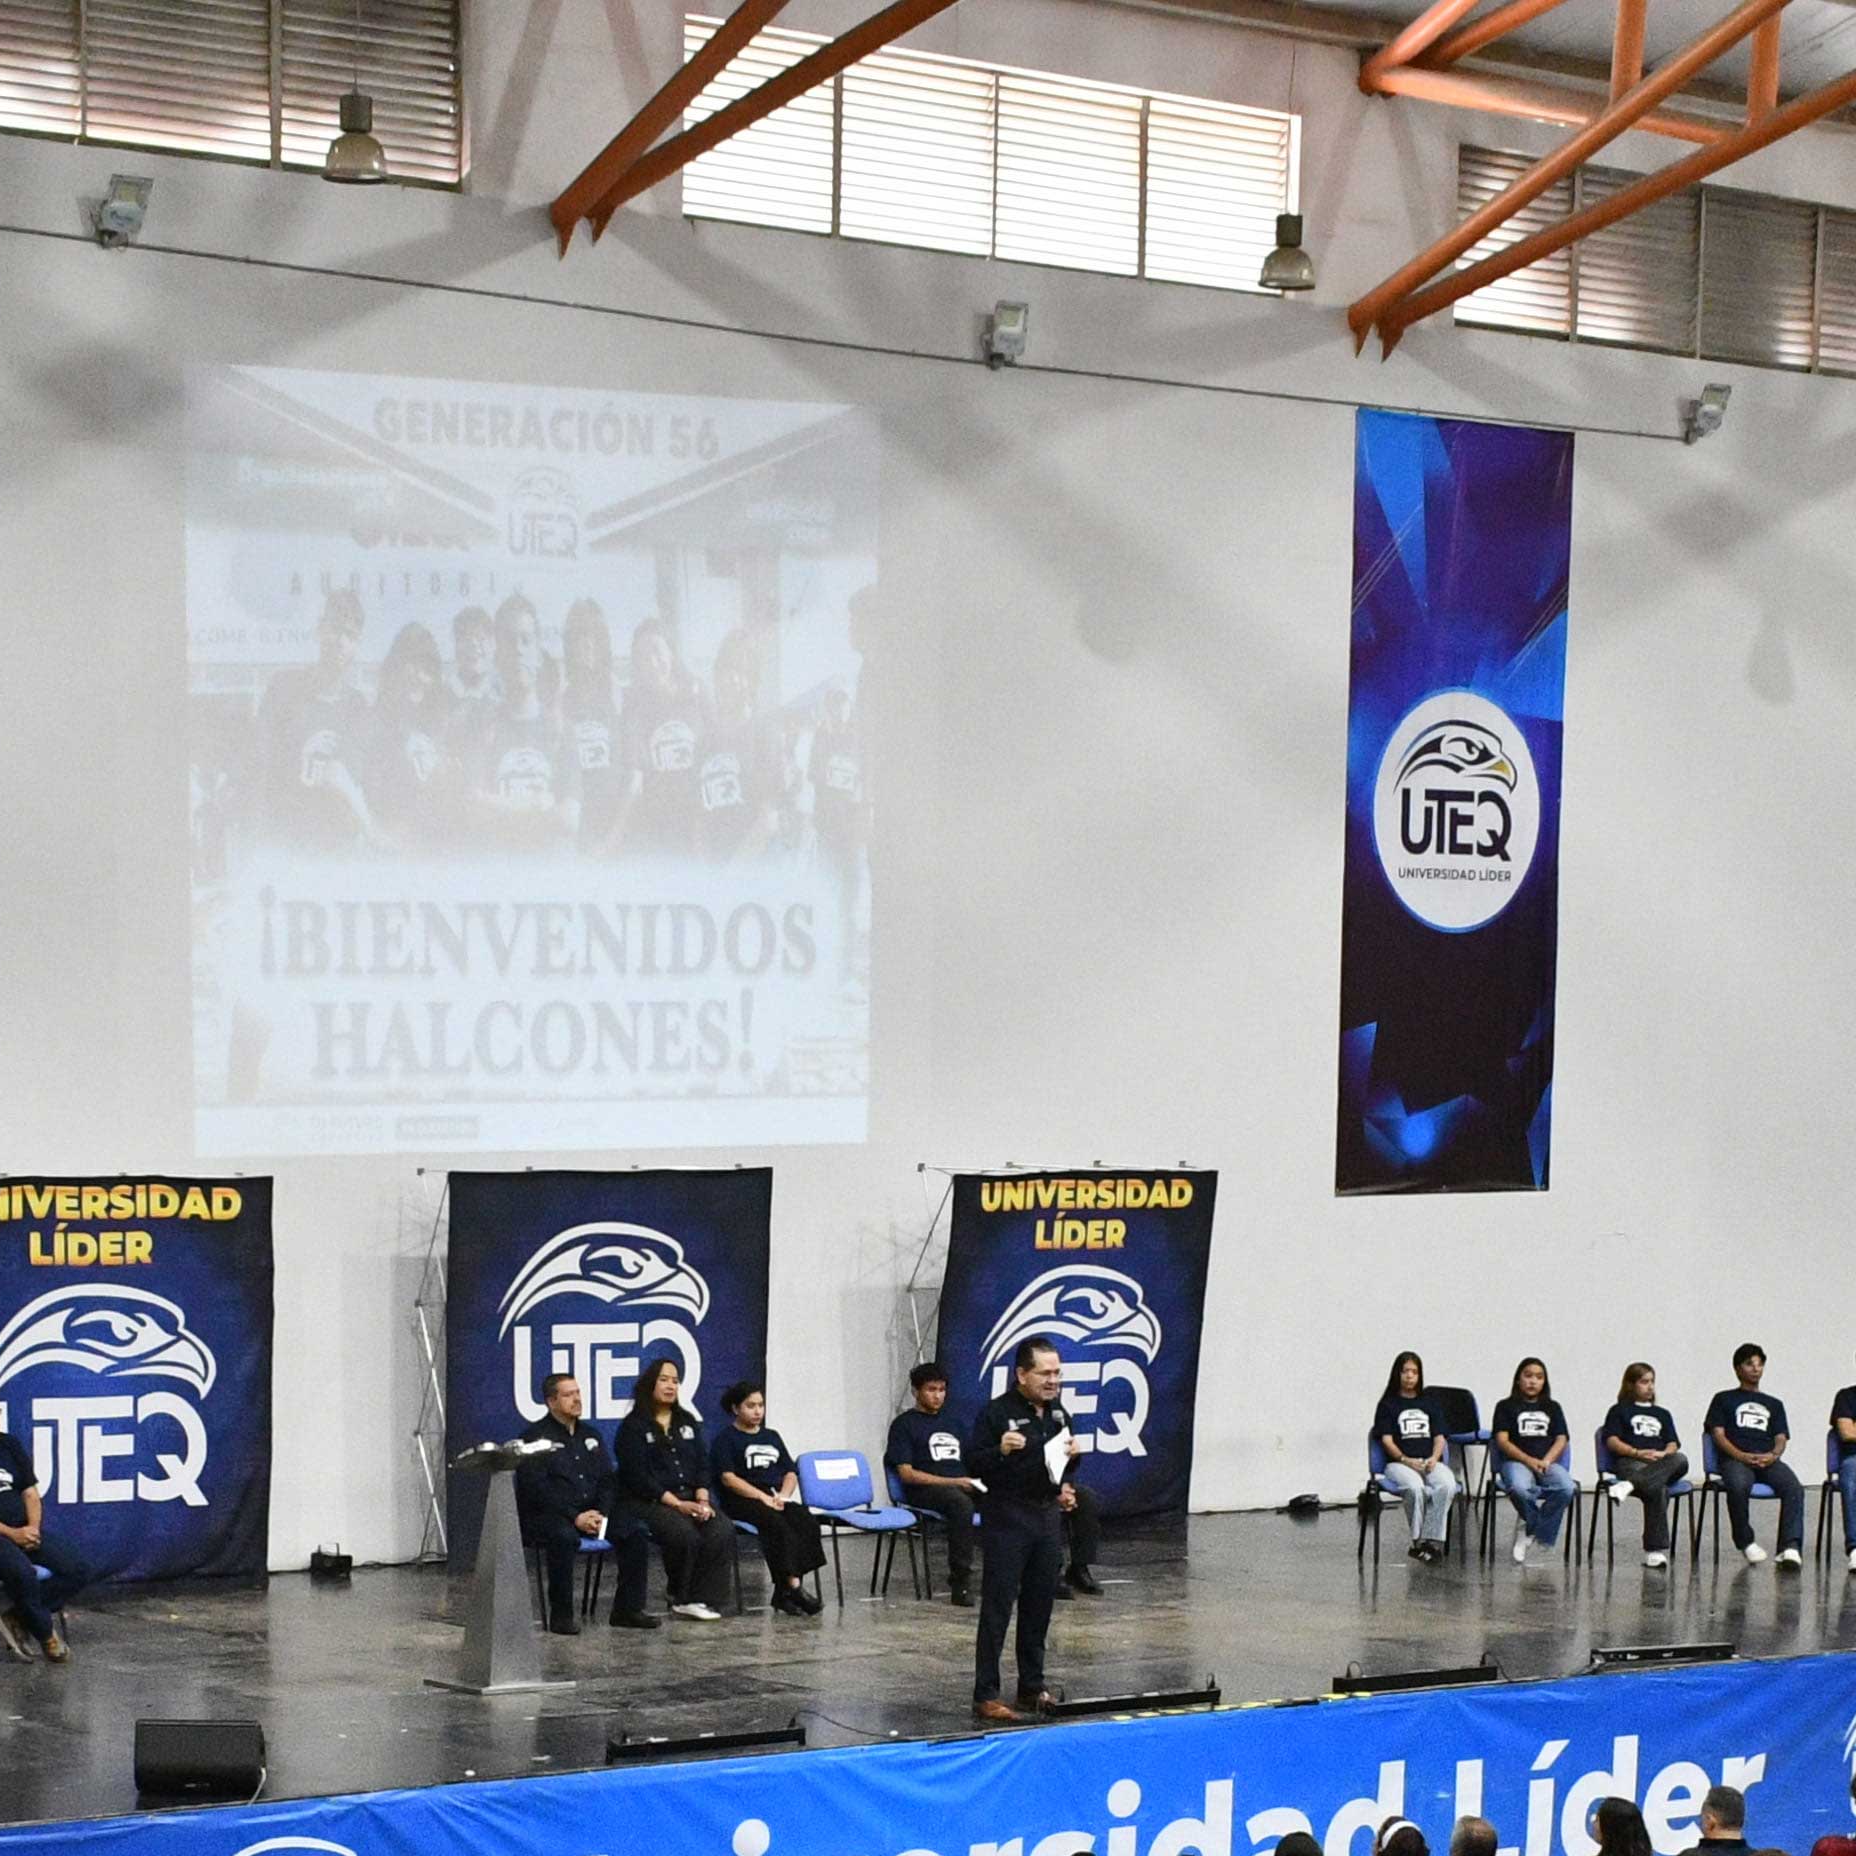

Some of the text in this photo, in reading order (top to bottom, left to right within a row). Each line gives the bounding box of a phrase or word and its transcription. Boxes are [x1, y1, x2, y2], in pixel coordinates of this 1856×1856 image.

[373, 395, 719, 463] GENERACIÓN 56
[1400, 787, 1512, 862] UTEQ
[1398, 867, 1512, 882] UNIVERSIDAD LÍDER
[258, 886, 818, 983] ¡BIENVENIDOS
[312, 986, 755, 1078] HALCONES!
[981, 1178, 1194, 1212] UNIVERSIDAD
[29, 1223, 153, 1267] LÍDER
[1034, 1211, 1127, 1251] LÍDER
[513, 1319, 703, 1423] UTEQ
